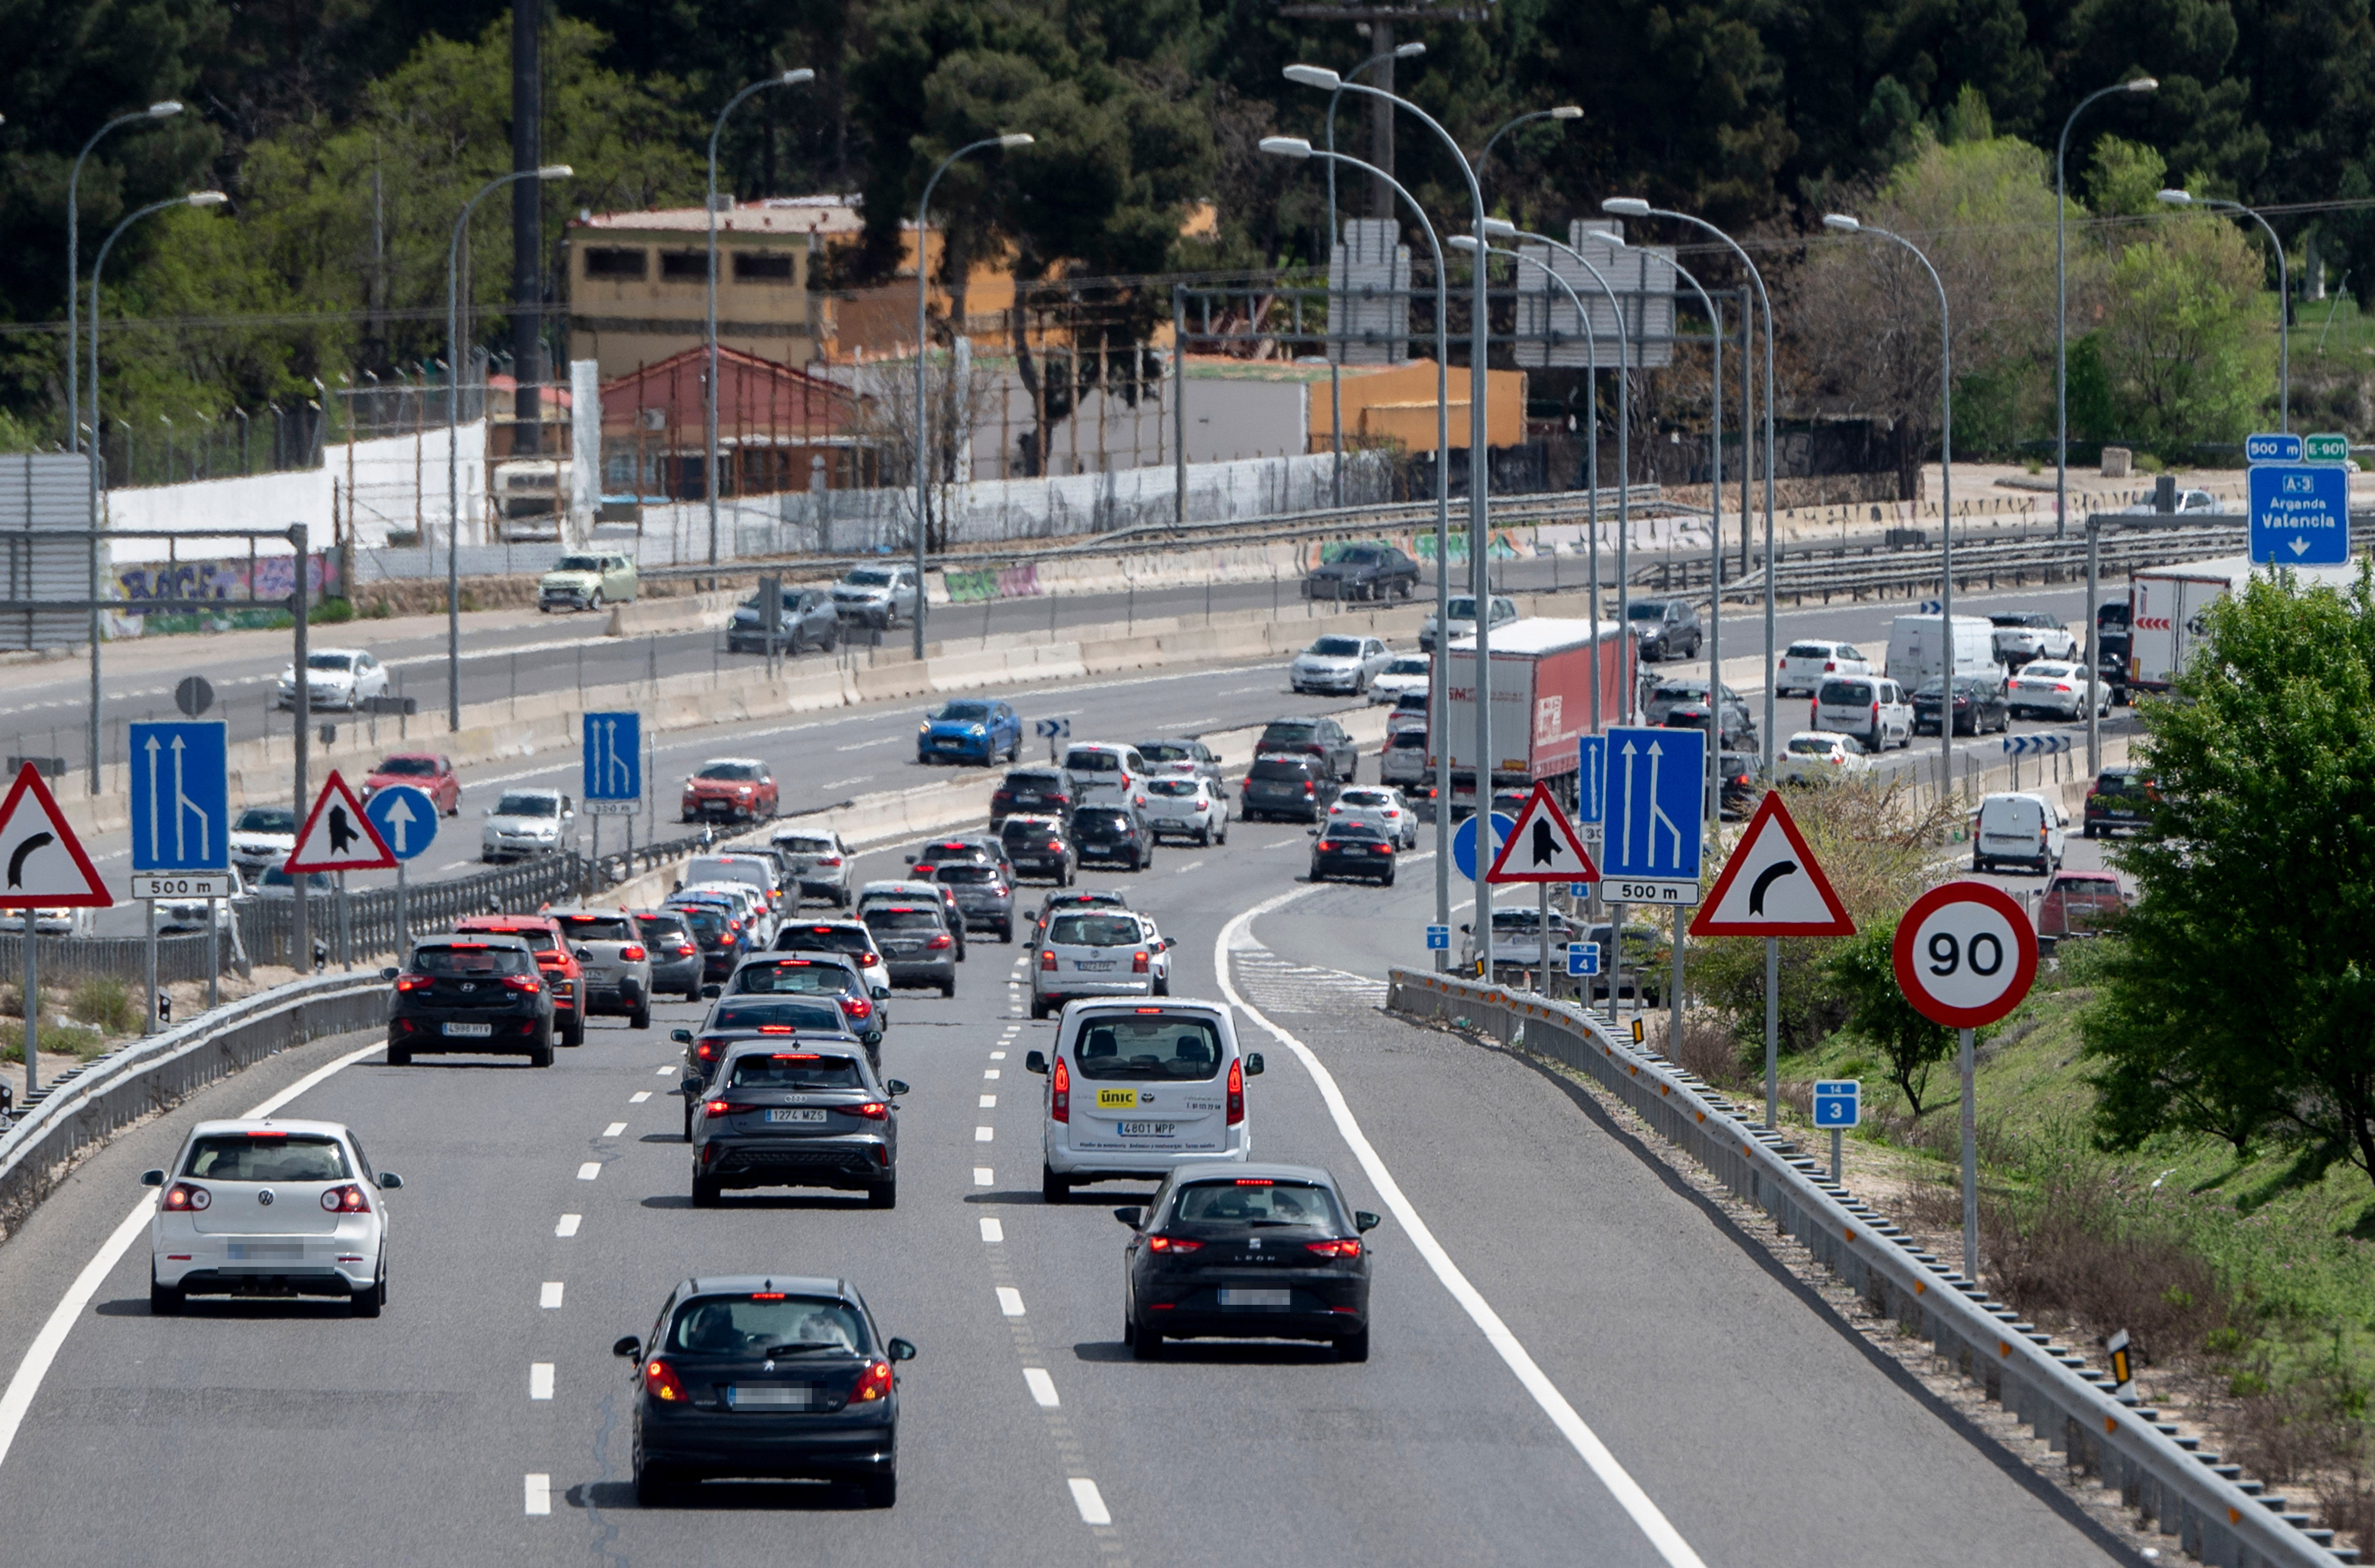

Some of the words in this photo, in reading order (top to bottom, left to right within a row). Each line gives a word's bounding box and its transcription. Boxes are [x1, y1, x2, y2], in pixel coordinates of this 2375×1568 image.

[2251, 442, 2277, 455] 500
[2287, 445, 2298, 455] m
[2309, 442, 2345, 455] E-901
[2286, 476, 2311, 492] A-3
[2270, 497, 2326, 512] Arganda
[2262, 512, 2335, 529] Valencia
[151, 880, 188, 894] 500
[197, 882, 211, 893] m
[1622, 884, 1656, 898] 500
[1663, 888, 1678, 900] m
[1928, 932, 2003, 977] 90
[1579, 958, 1589, 970] 4
[1830, 1085, 1842, 1094] 14
[774, 1111, 797, 1120] 1274
[802, 1111, 824, 1120] MZS
[1830, 1102, 1842, 1119] 3
[1124, 1123, 1151, 1134] 4801
[1155, 1123, 1175, 1134] MPP
